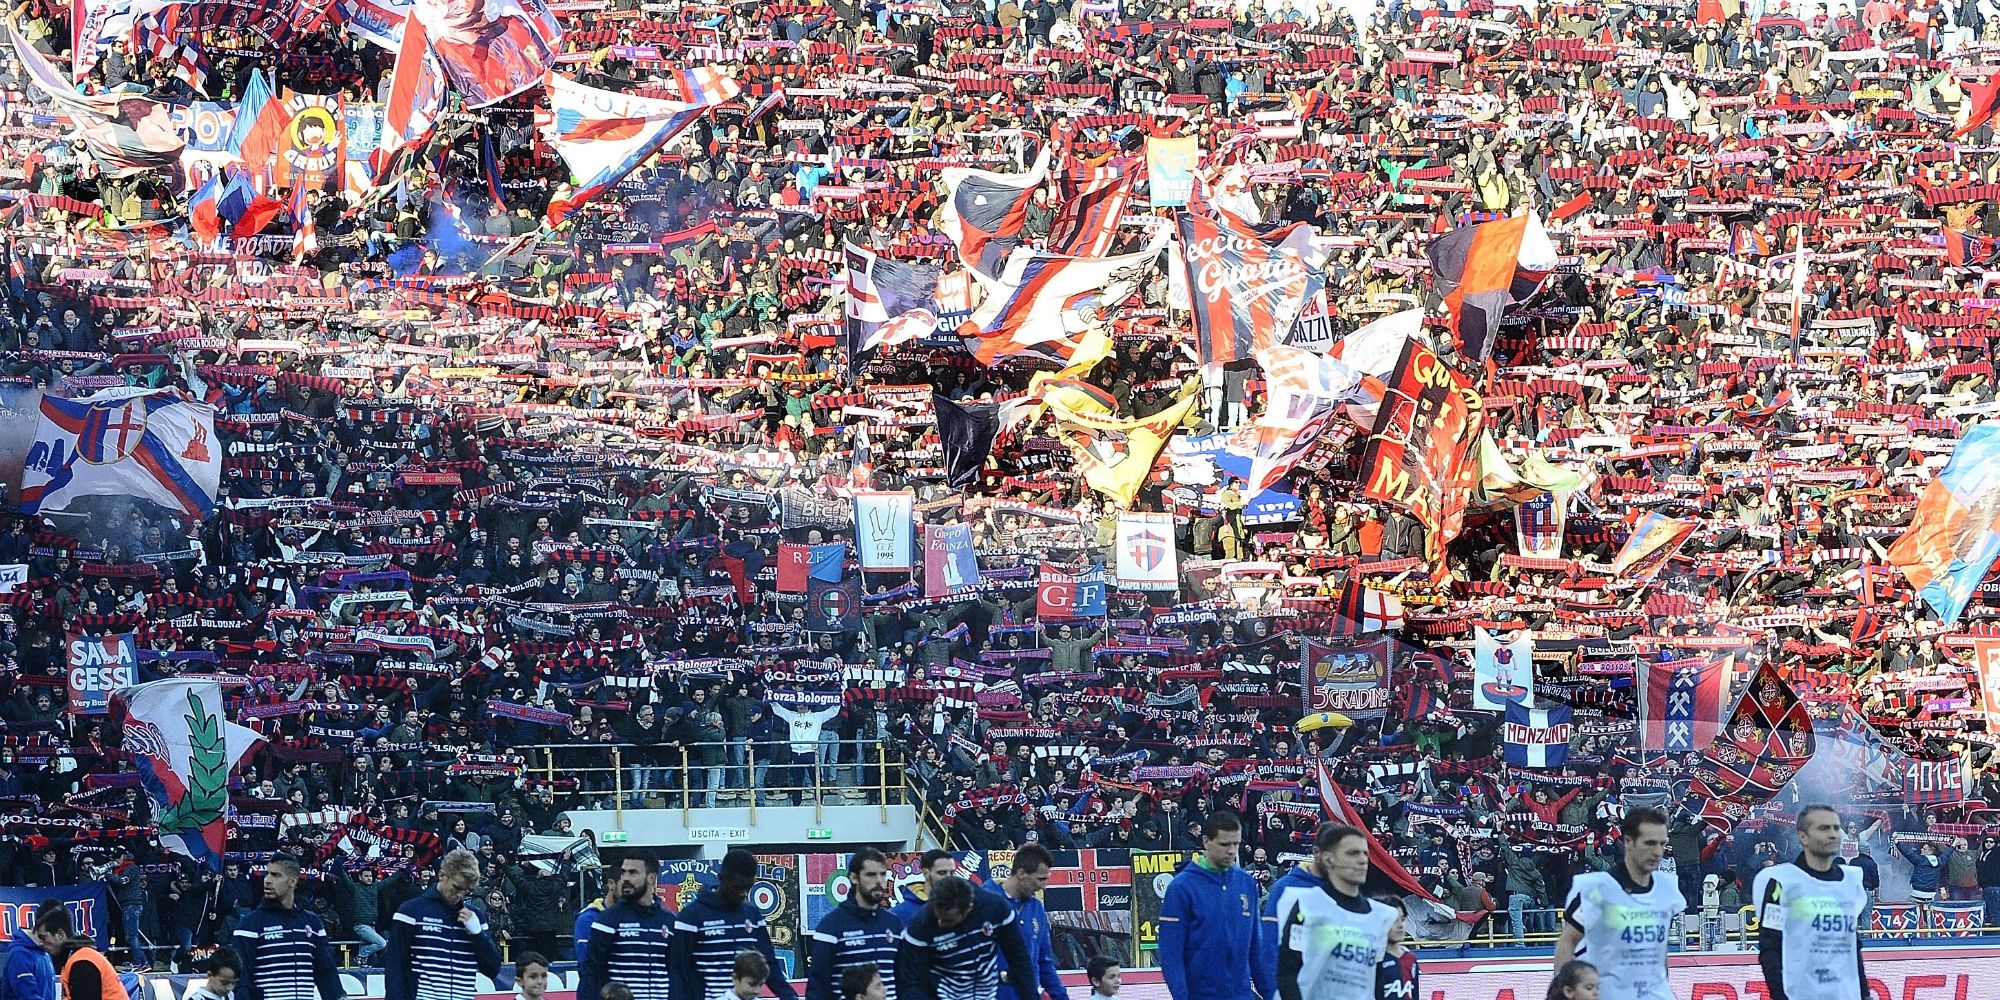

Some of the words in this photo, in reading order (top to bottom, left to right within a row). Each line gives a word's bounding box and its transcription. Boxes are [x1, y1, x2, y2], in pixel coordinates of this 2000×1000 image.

[326, 369, 368, 377] BOLOGNA
[250, 413, 279, 422] BOLOGNA
[611, 459, 642, 468] JUVE
[1178, 610, 1217, 624] Bologna
[201, 619, 241, 628] BOLOGNA
[677, 660, 718, 671] Bologna
[71, 667, 132, 690] GESSI
[765, 671, 840, 682] BOLOGNA
[767, 690, 796, 702] Forza
[797, 691, 841, 703] Bologna
[73, 700, 90, 708] Very
[991, 729, 1024, 738] BOLOGNA
[1026, 729, 1034, 737] FC
[1036, 729, 1055, 738] 1909
[1507, 723, 1569, 743] MONZUNO
[1044, 810, 1066, 821] FINO
[692, 830, 720, 839] USCITA
[730, 830, 747, 838] EXIT
[669, 862, 693, 874] NOI
[694, 862, 710, 874] DI
[1068, 871, 1109, 883] 1909
[1883, 915, 1902, 927] 74
[1947, 917, 1966, 929] 74
